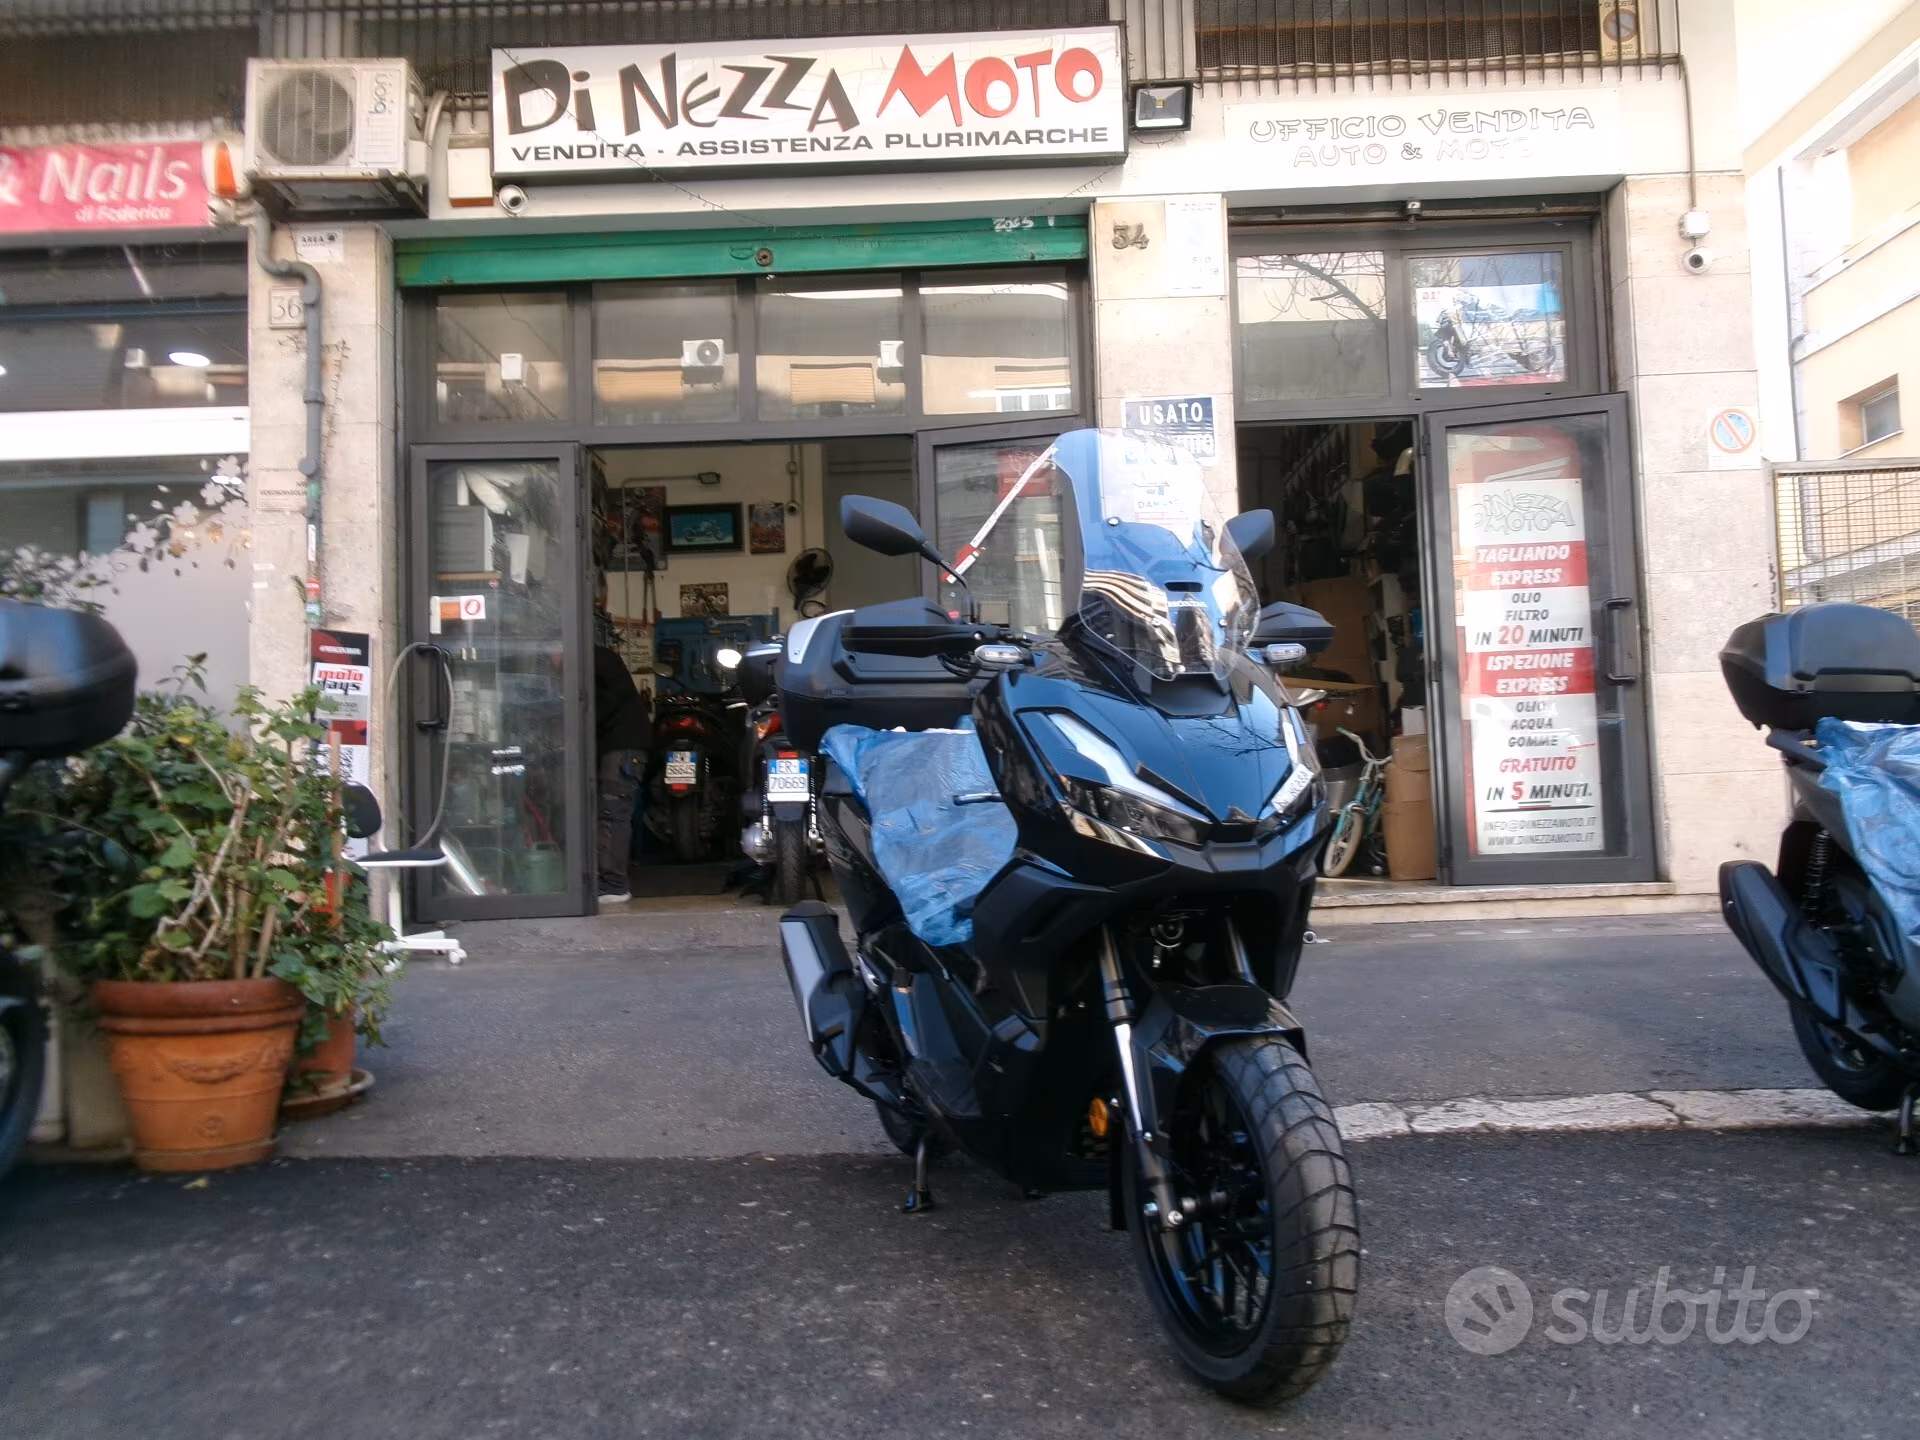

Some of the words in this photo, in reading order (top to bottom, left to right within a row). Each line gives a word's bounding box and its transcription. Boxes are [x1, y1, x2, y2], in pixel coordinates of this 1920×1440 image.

[502, 59, 597, 135] Di
[876, 43, 1103, 127] MOTO
[1249, 115, 1407, 143] UFFICIO
[1418, 107, 1595, 135] VENDITA
[511, 142, 645, 161] VENDITA
[676, 135, 873, 156] ASSISTENZA
[885, 127, 1109, 149] PLURIMARCHE
[1293, 143, 1388, 168] AUTO
[1400, 142, 1424, 161] &
[39, 146, 190, 203] Nails
[1111, 222, 1150, 250] 34
[271, 295, 302, 321] 36
[1139, 402, 1204, 426] USATO
[1475, 544, 1571, 564] TAGLIANDO
[1490, 567, 1563, 586] EXPRESS
[1511, 592, 1541, 604] OLIO
[1504, 608, 1549, 622] FILTRO
[1474, 631, 1492, 646] IN
[1498, 624, 1524, 645] 20
[1528, 626, 1585, 644] MINUTI
[1486, 652, 1576, 671] ISPEZIONE
[1495, 675, 1569, 695] EXPRESS
[1510, 718, 1553, 731] ACQUA
[1508, 735, 1559, 748] GOMME
[1499, 756, 1577, 773] GRATUITO
[770, 776, 807, 790] 70669
[1486, 786, 1505, 801] IN
[1511, 781, 1525, 801] 5
